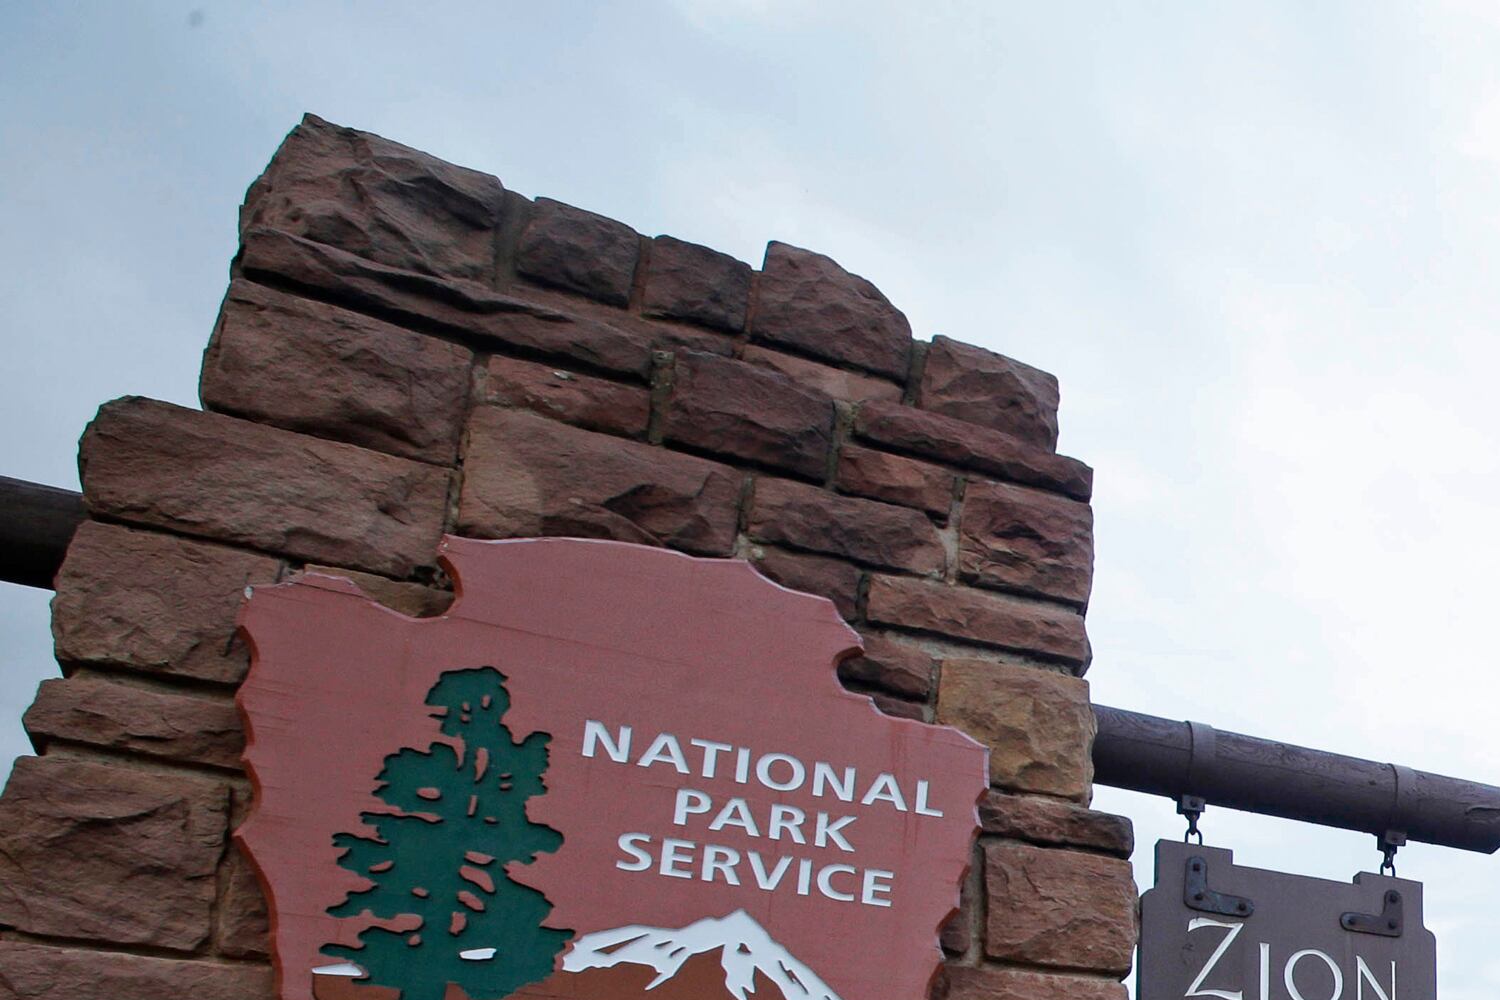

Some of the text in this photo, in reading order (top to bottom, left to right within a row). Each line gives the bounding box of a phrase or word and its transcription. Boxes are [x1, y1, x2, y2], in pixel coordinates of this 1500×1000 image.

[581, 719, 944, 818] NATIONAL
[673, 788, 857, 852] PARK
[615, 831, 895, 907] SERVICE
